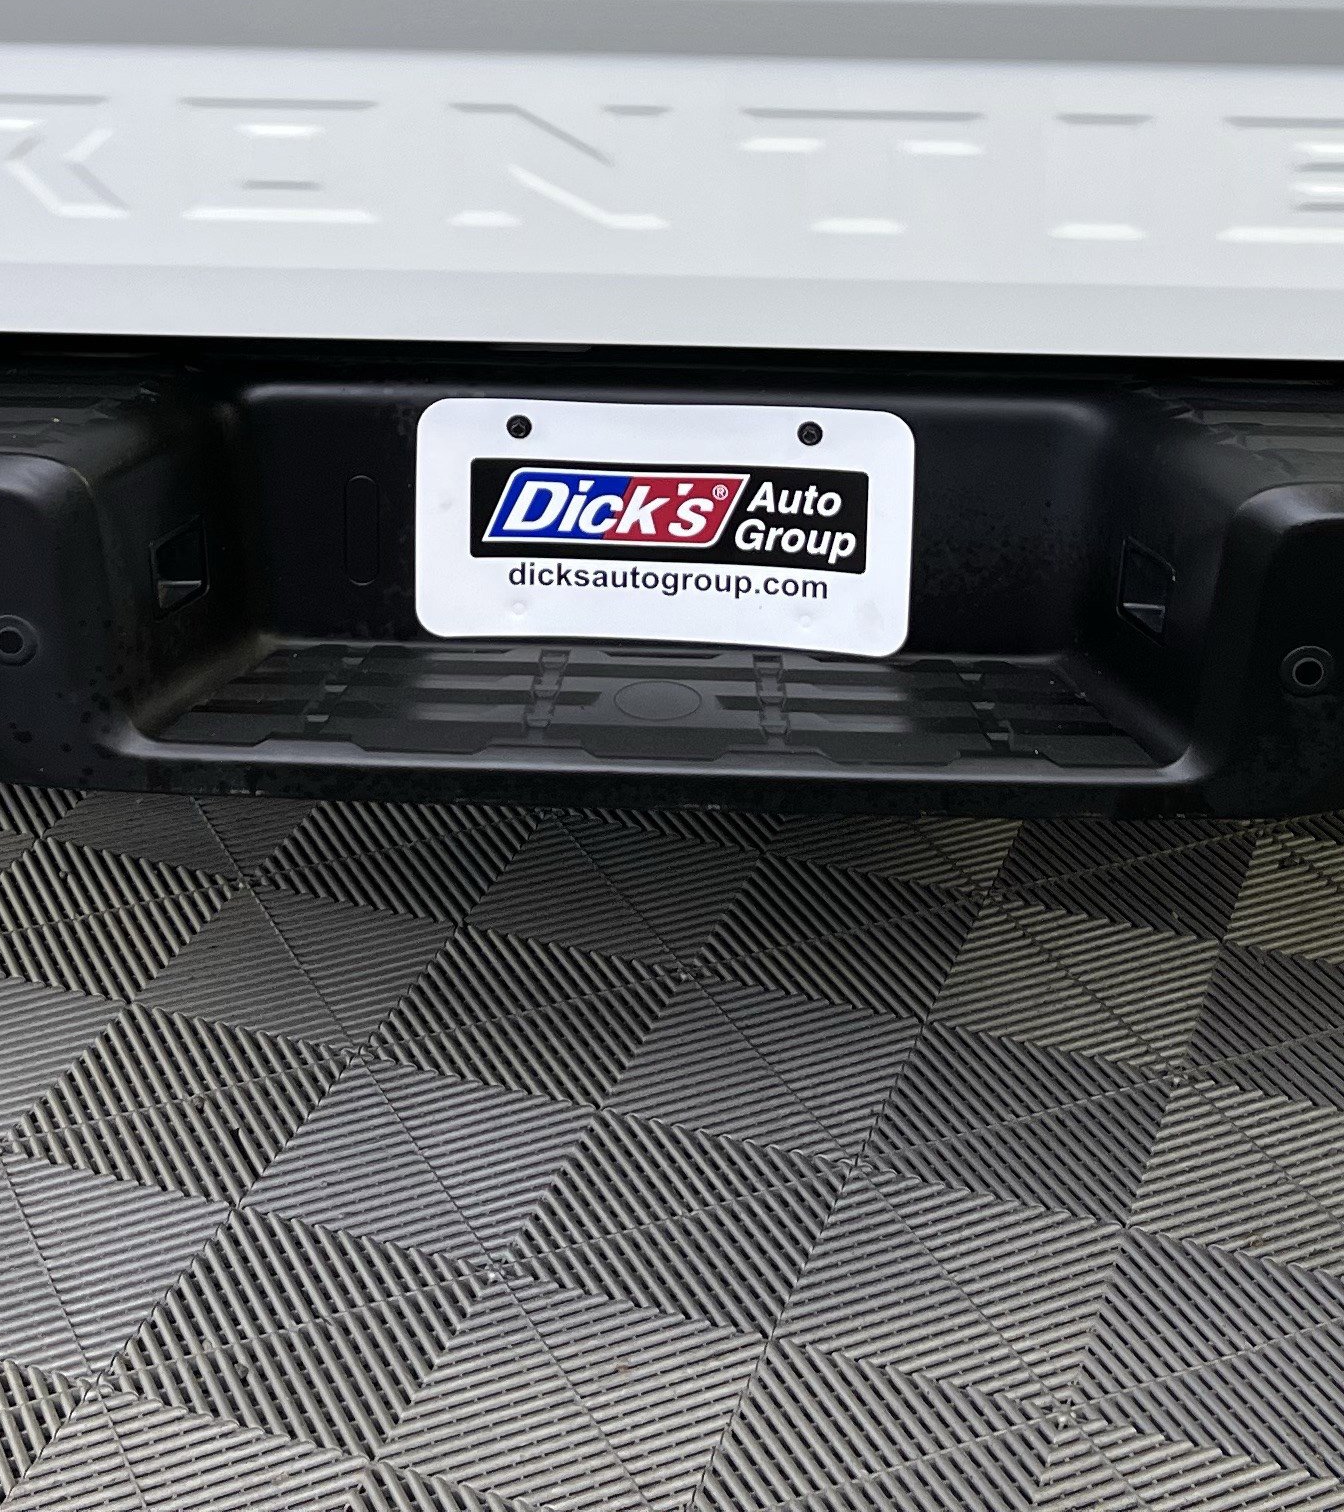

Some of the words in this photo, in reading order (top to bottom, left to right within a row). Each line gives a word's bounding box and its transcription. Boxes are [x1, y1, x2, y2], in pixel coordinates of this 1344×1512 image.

[502, 479, 714, 538] Dick's
[748, 481, 842, 518] Auto
[734, 518, 857, 564] Group
[508, 561, 829, 600] dicksautogroup.com
